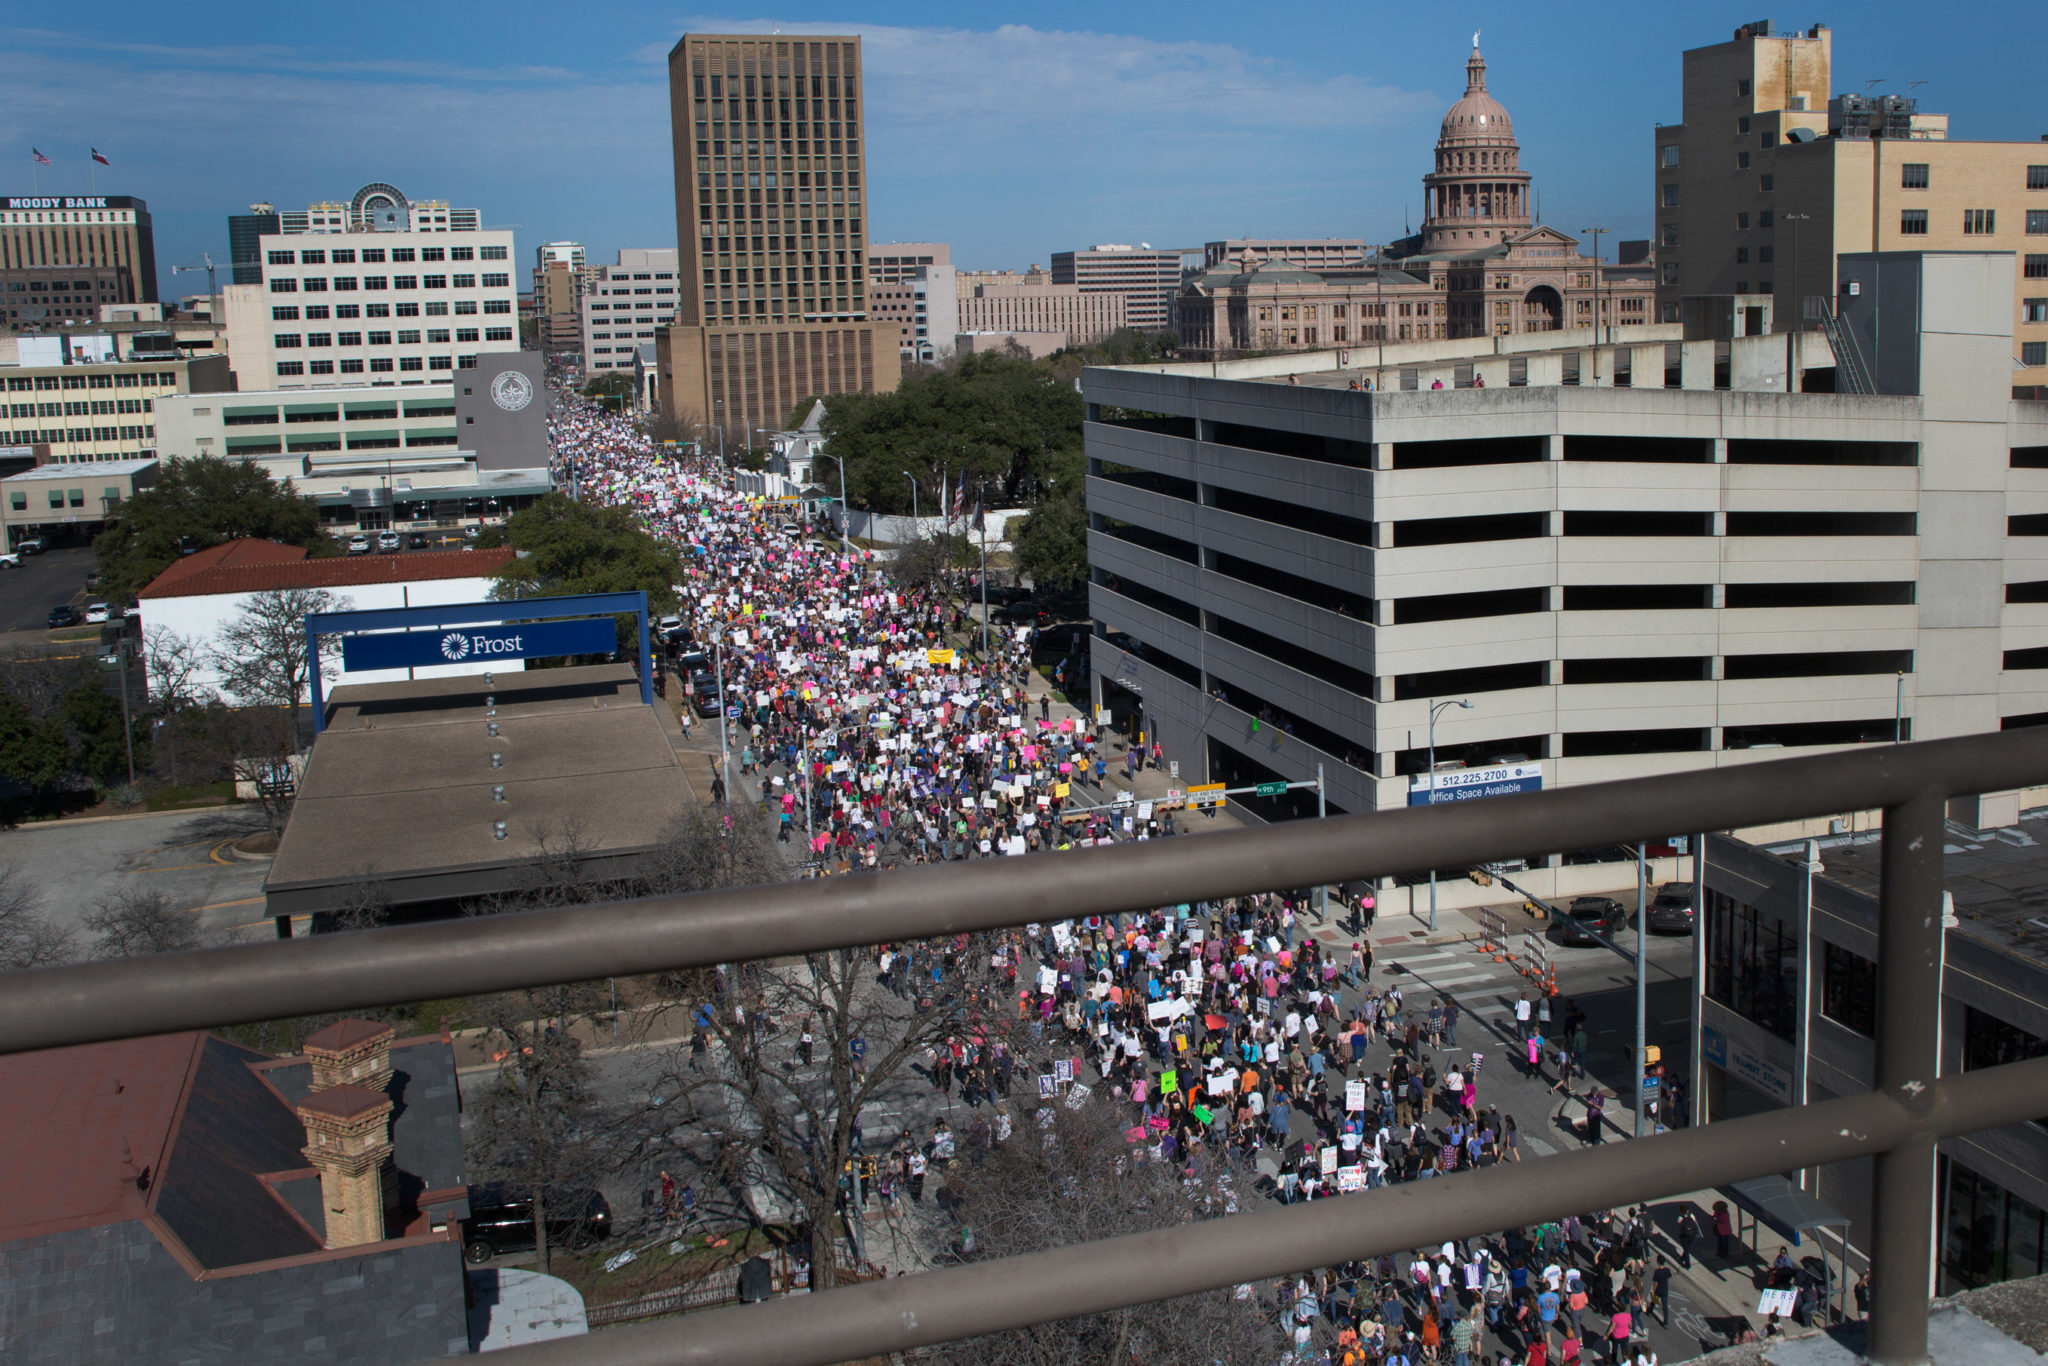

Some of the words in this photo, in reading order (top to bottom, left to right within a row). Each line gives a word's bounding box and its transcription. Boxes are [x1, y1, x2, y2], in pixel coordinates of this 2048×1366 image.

[9, 198, 60, 209] MOODY
[65, 197, 107, 208] BANK
[472, 635, 523, 655] Frost
[1442, 770, 1507, 786] 512.225.2700
[1429, 791, 1454, 802] Office
[1456, 788, 1482, 801] Space
[1485, 782, 1521, 796] Available
[1340, 1178, 1360, 1188] LOVE
